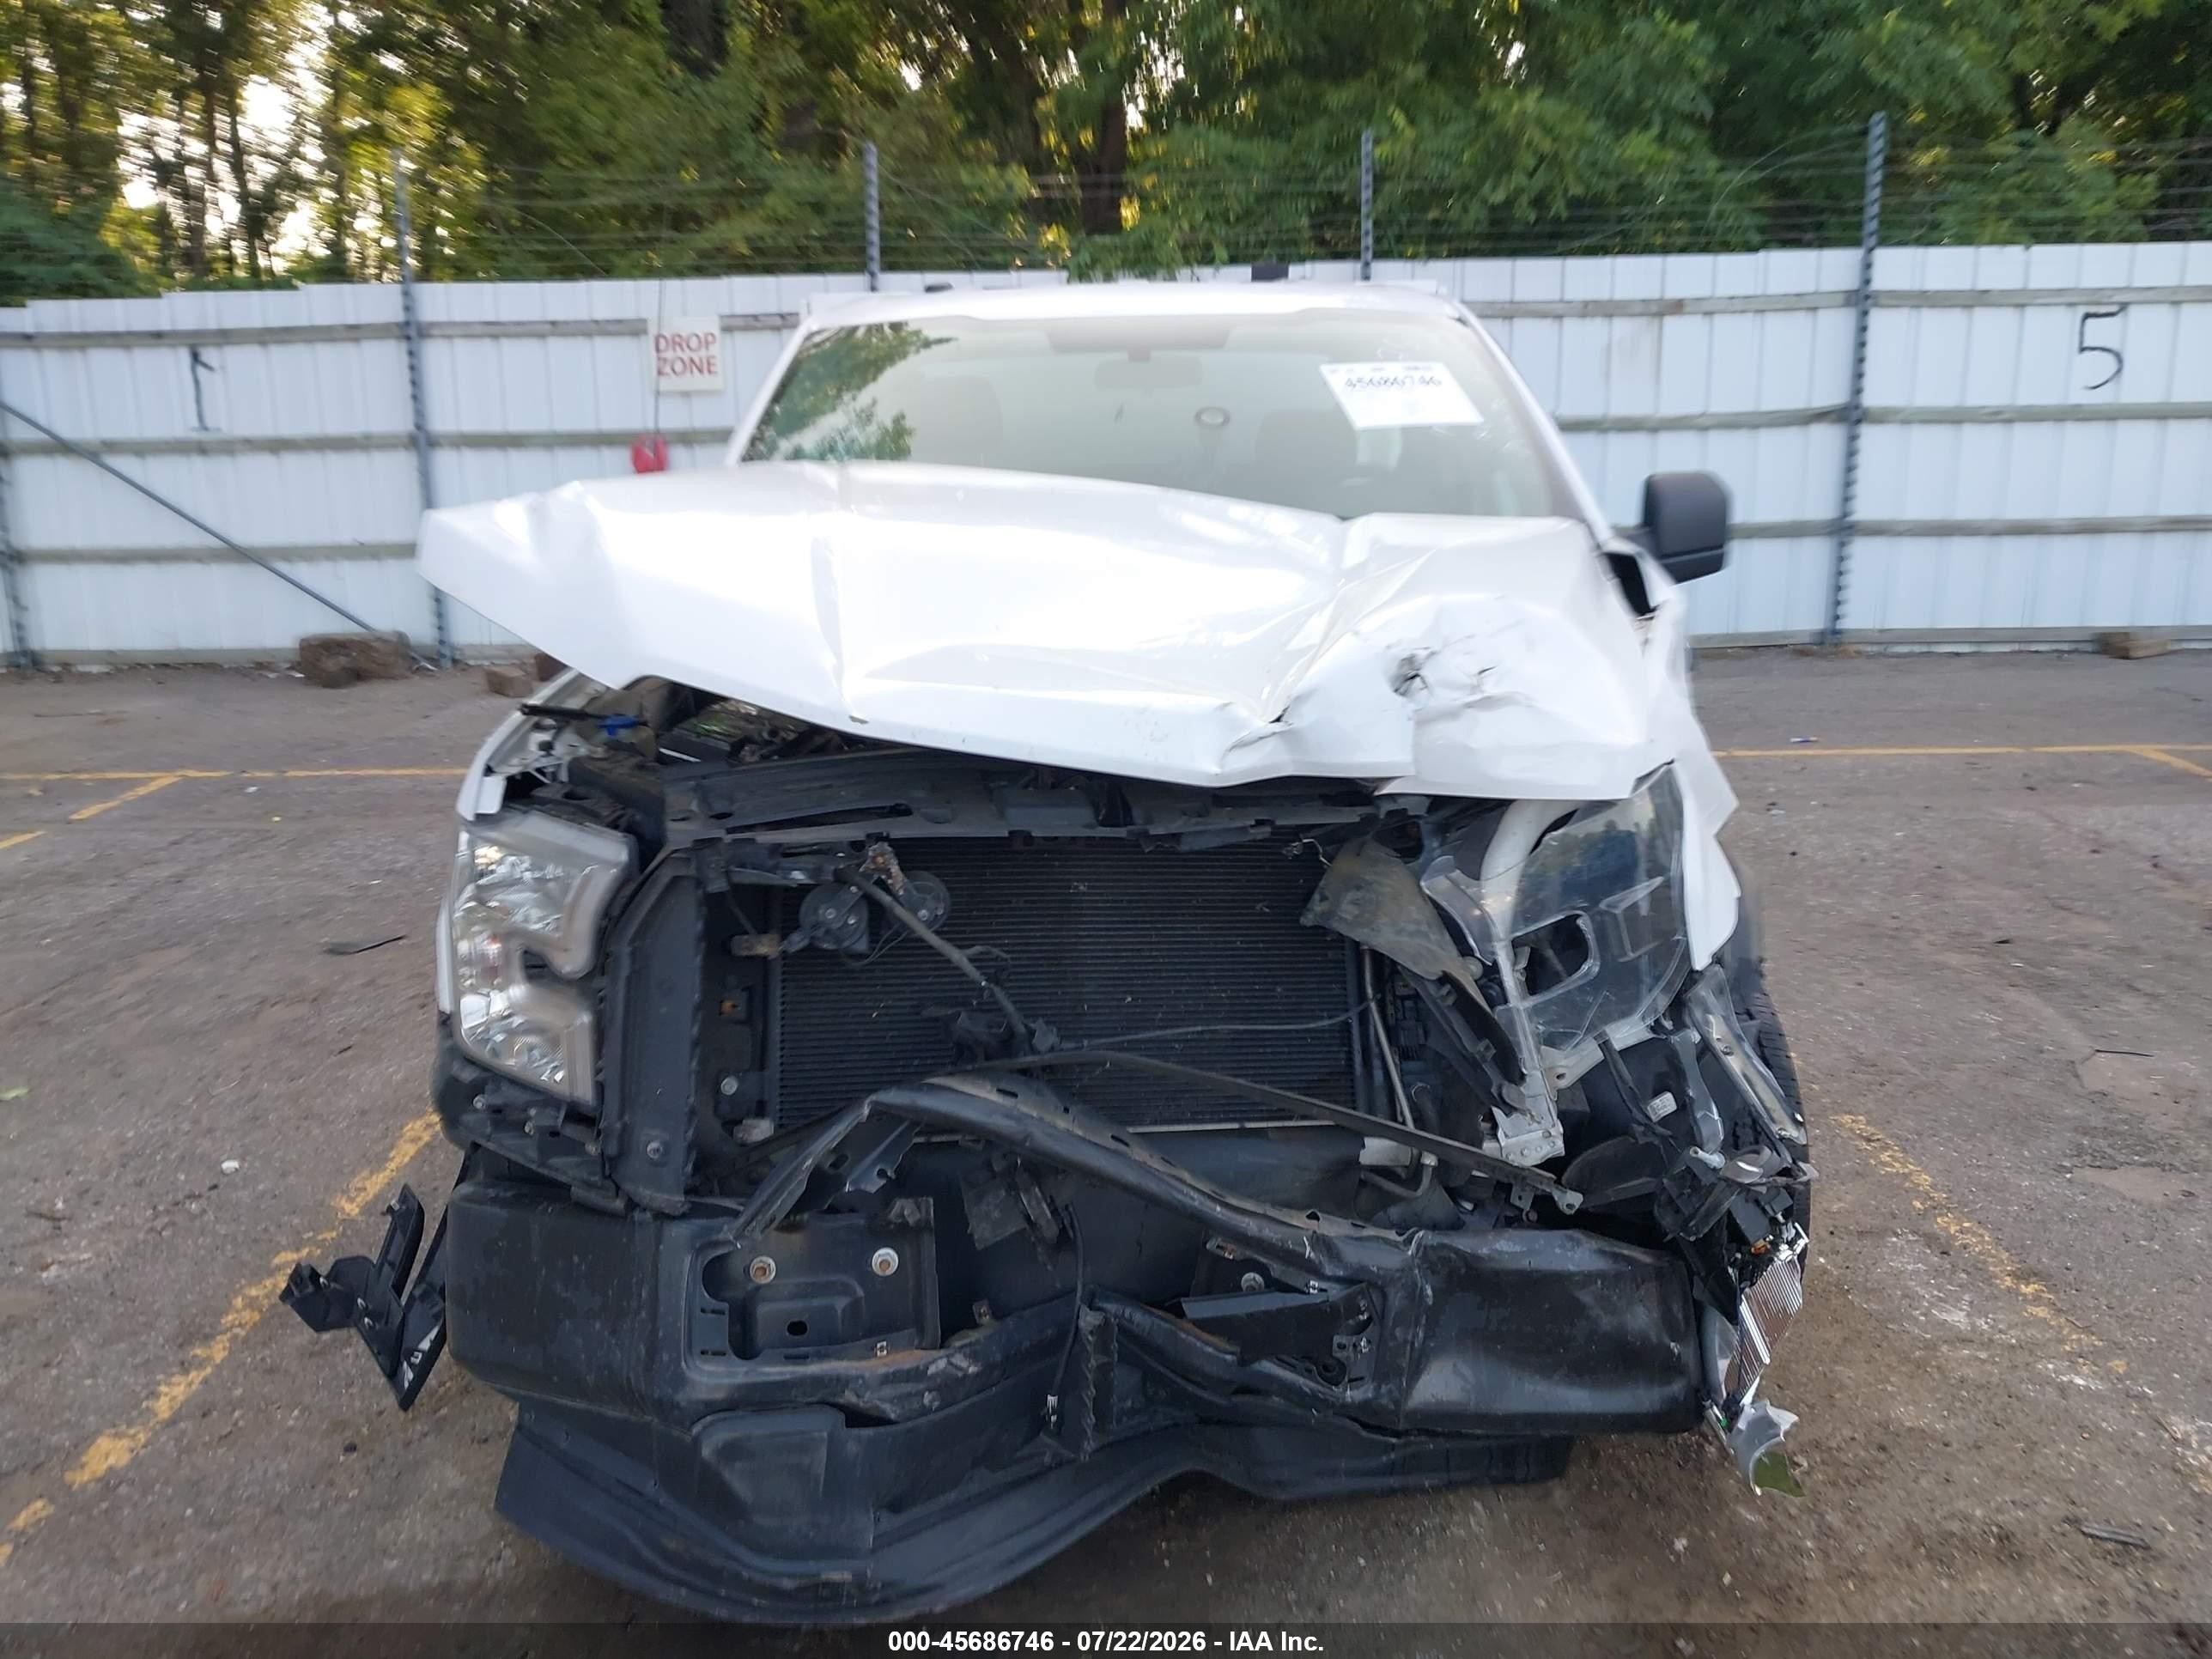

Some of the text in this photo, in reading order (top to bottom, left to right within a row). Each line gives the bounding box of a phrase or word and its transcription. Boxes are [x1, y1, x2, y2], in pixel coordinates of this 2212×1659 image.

[654, 332, 716, 353] DROP
[2078, 303, 2129, 390] 5
[657, 356, 718, 376] ZONE
